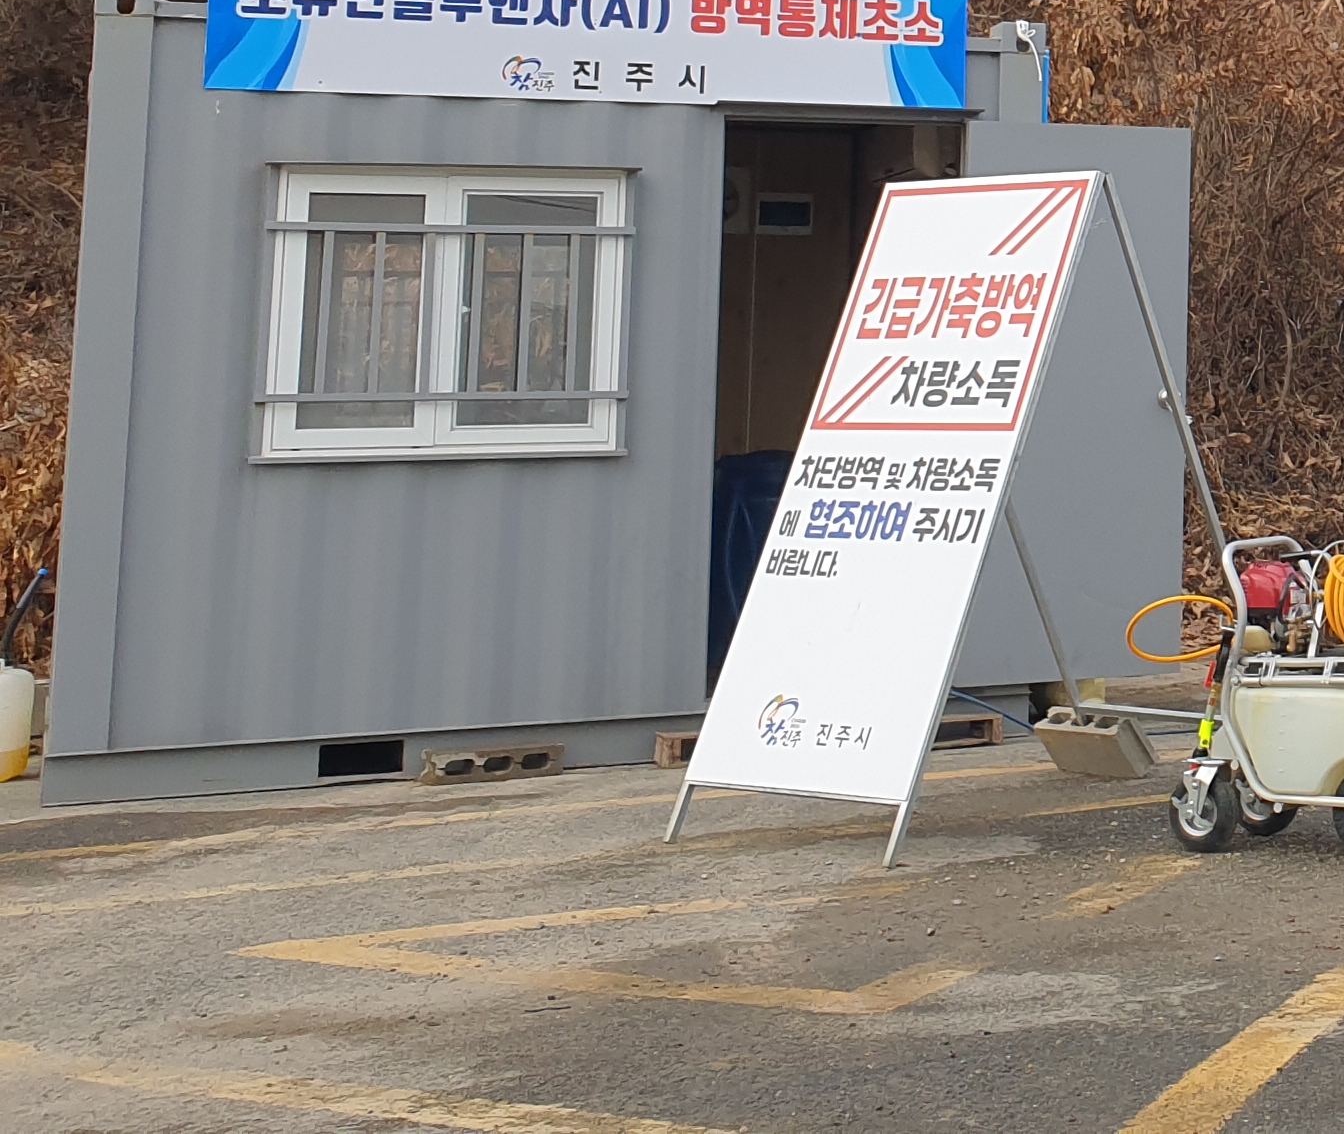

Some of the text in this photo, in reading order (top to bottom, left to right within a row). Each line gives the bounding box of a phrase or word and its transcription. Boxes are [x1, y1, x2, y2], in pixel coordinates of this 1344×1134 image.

[856, 272, 1048, 340] 긴급가축방역
[890, 359, 1021, 407] 차량소독
[794, 456, 1001, 492] 차단방역 및 차량소독
[779, 498, 986, 544] 에 협조하여 주시기
[765, 548, 839, 578] 바랍니다.
[816, 723, 873, 751] 진주시
